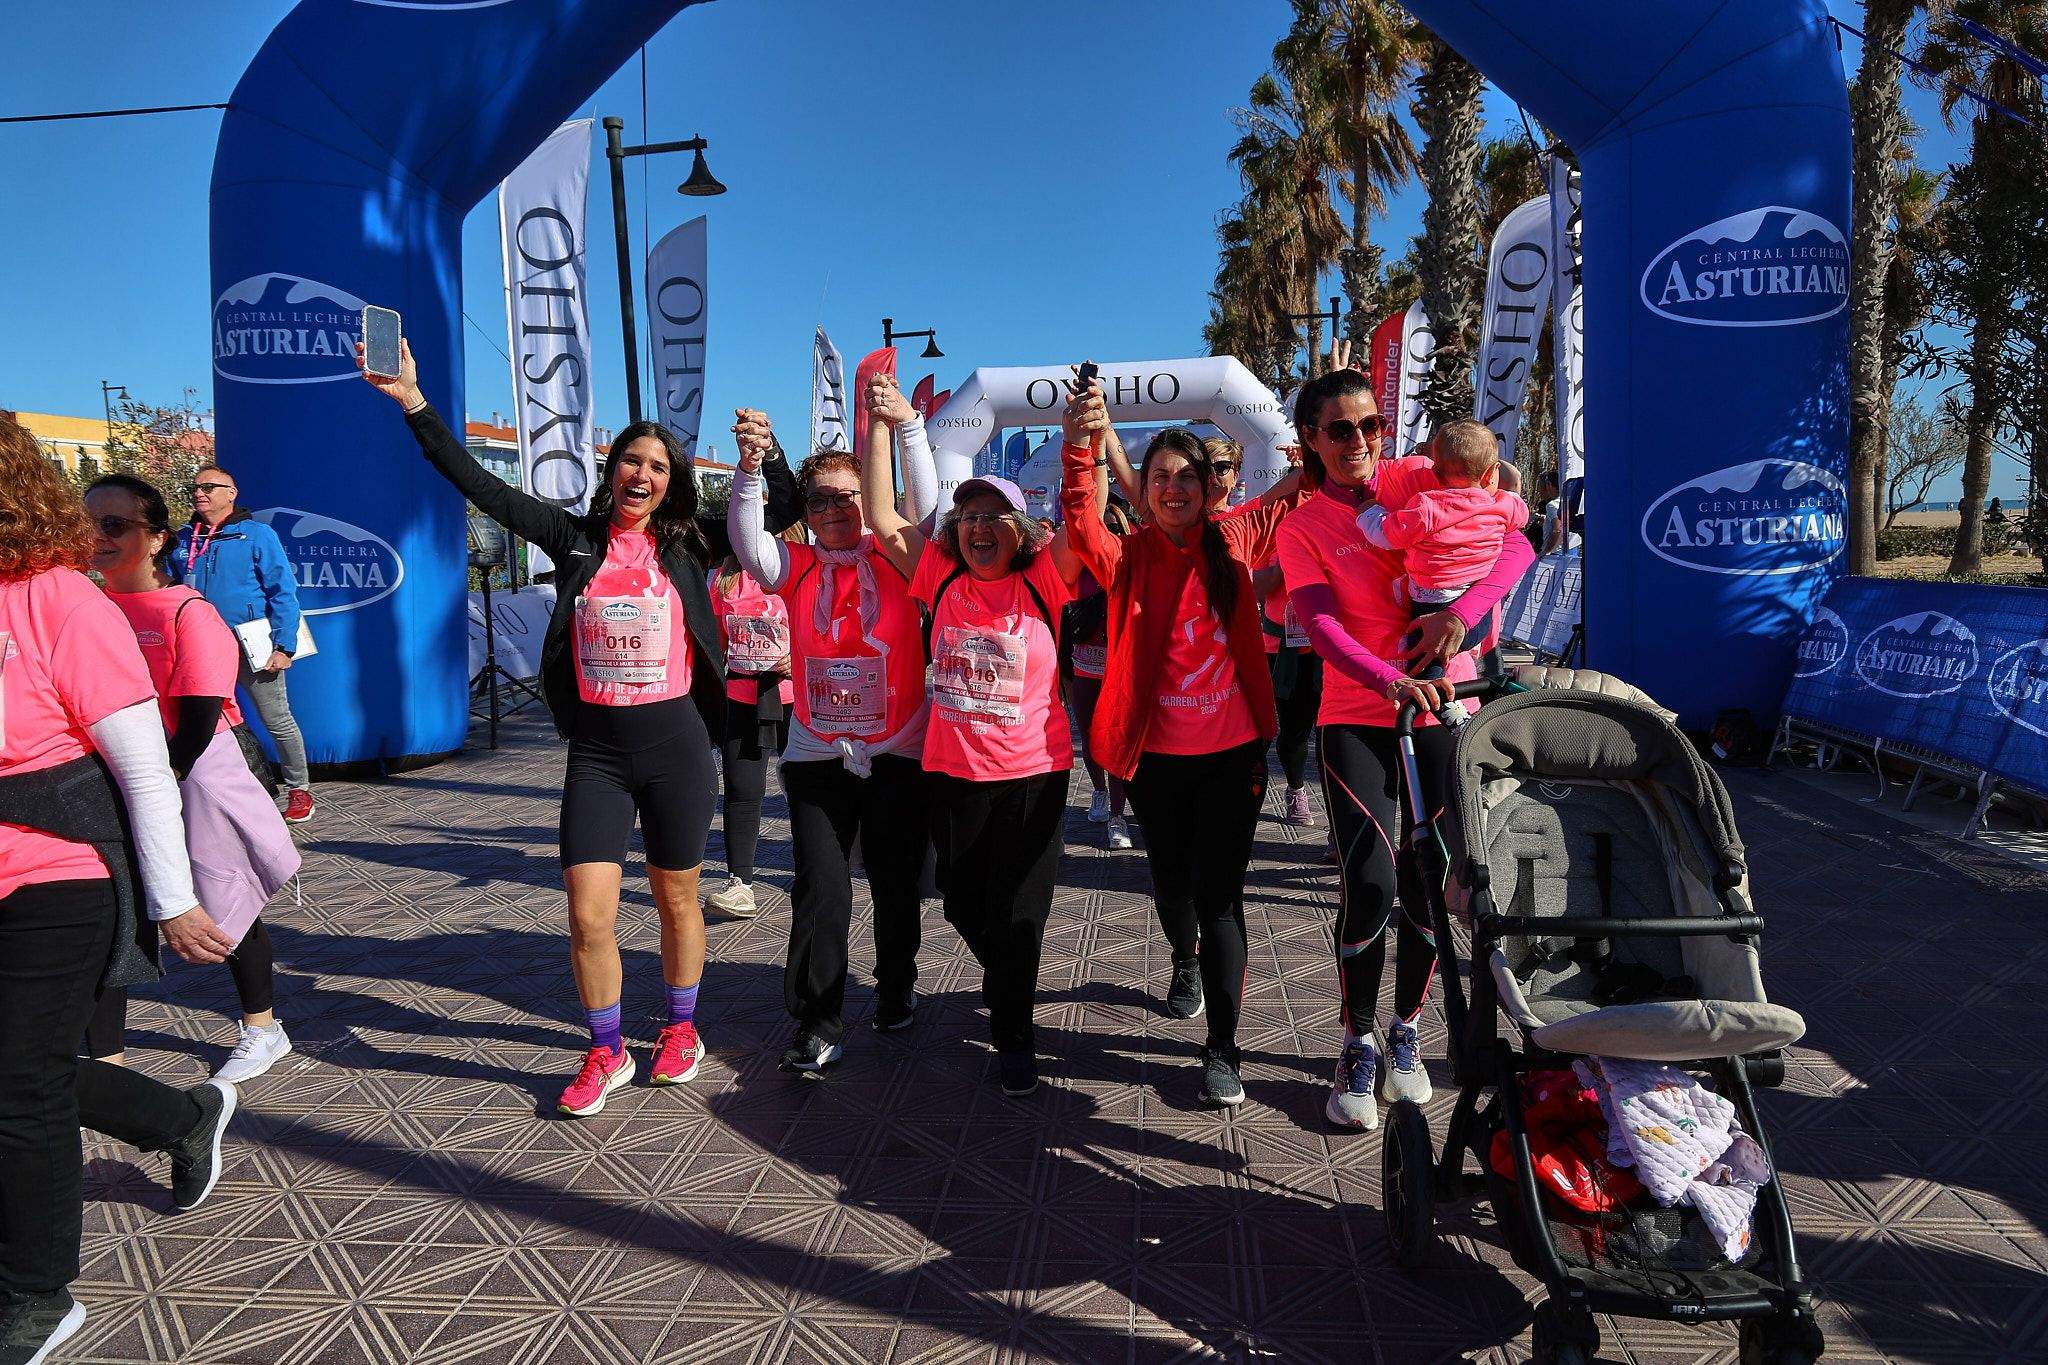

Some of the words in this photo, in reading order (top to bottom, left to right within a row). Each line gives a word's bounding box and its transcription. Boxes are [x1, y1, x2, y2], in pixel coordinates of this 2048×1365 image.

[1699, 248, 1783, 265] CENTRAL
[1791, 247, 1845, 260] LECHERA
[1658, 260, 1847, 306] ASTURIANA
[226, 312, 286, 324] CENTRAL
[293, 313, 362, 326] LECHER
[214, 318, 362, 359] ASTURIAN
[516, 206, 588, 507] OYSHO
[657, 276, 704, 449] YSHO
[1026, 373, 1180, 409] OHO
[1226, 402, 1273, 415] OYSHO
[937, 417, 982, 428] OYSHO
[1253, 468, 1284, 480] OYS
[1698, 499, 1781, 512] CENTRAL
[1658, 505, 1844, 548] ASTURIANA
[299, 545, 378, 557] LECHERA
[1535, 567, 1582, 611] OYSH
[604, 609, 638, 618] ASTURIANA
[605, 635, 642, 650] 016
[614, 652, 628, 660] 614
[1860, 637, 1967, 682] ASTURIANA
[963, 666, 996, 683] 016
[830, 692, 862, 706] 016
[1159, 695, 1198, 707] CARRERA
